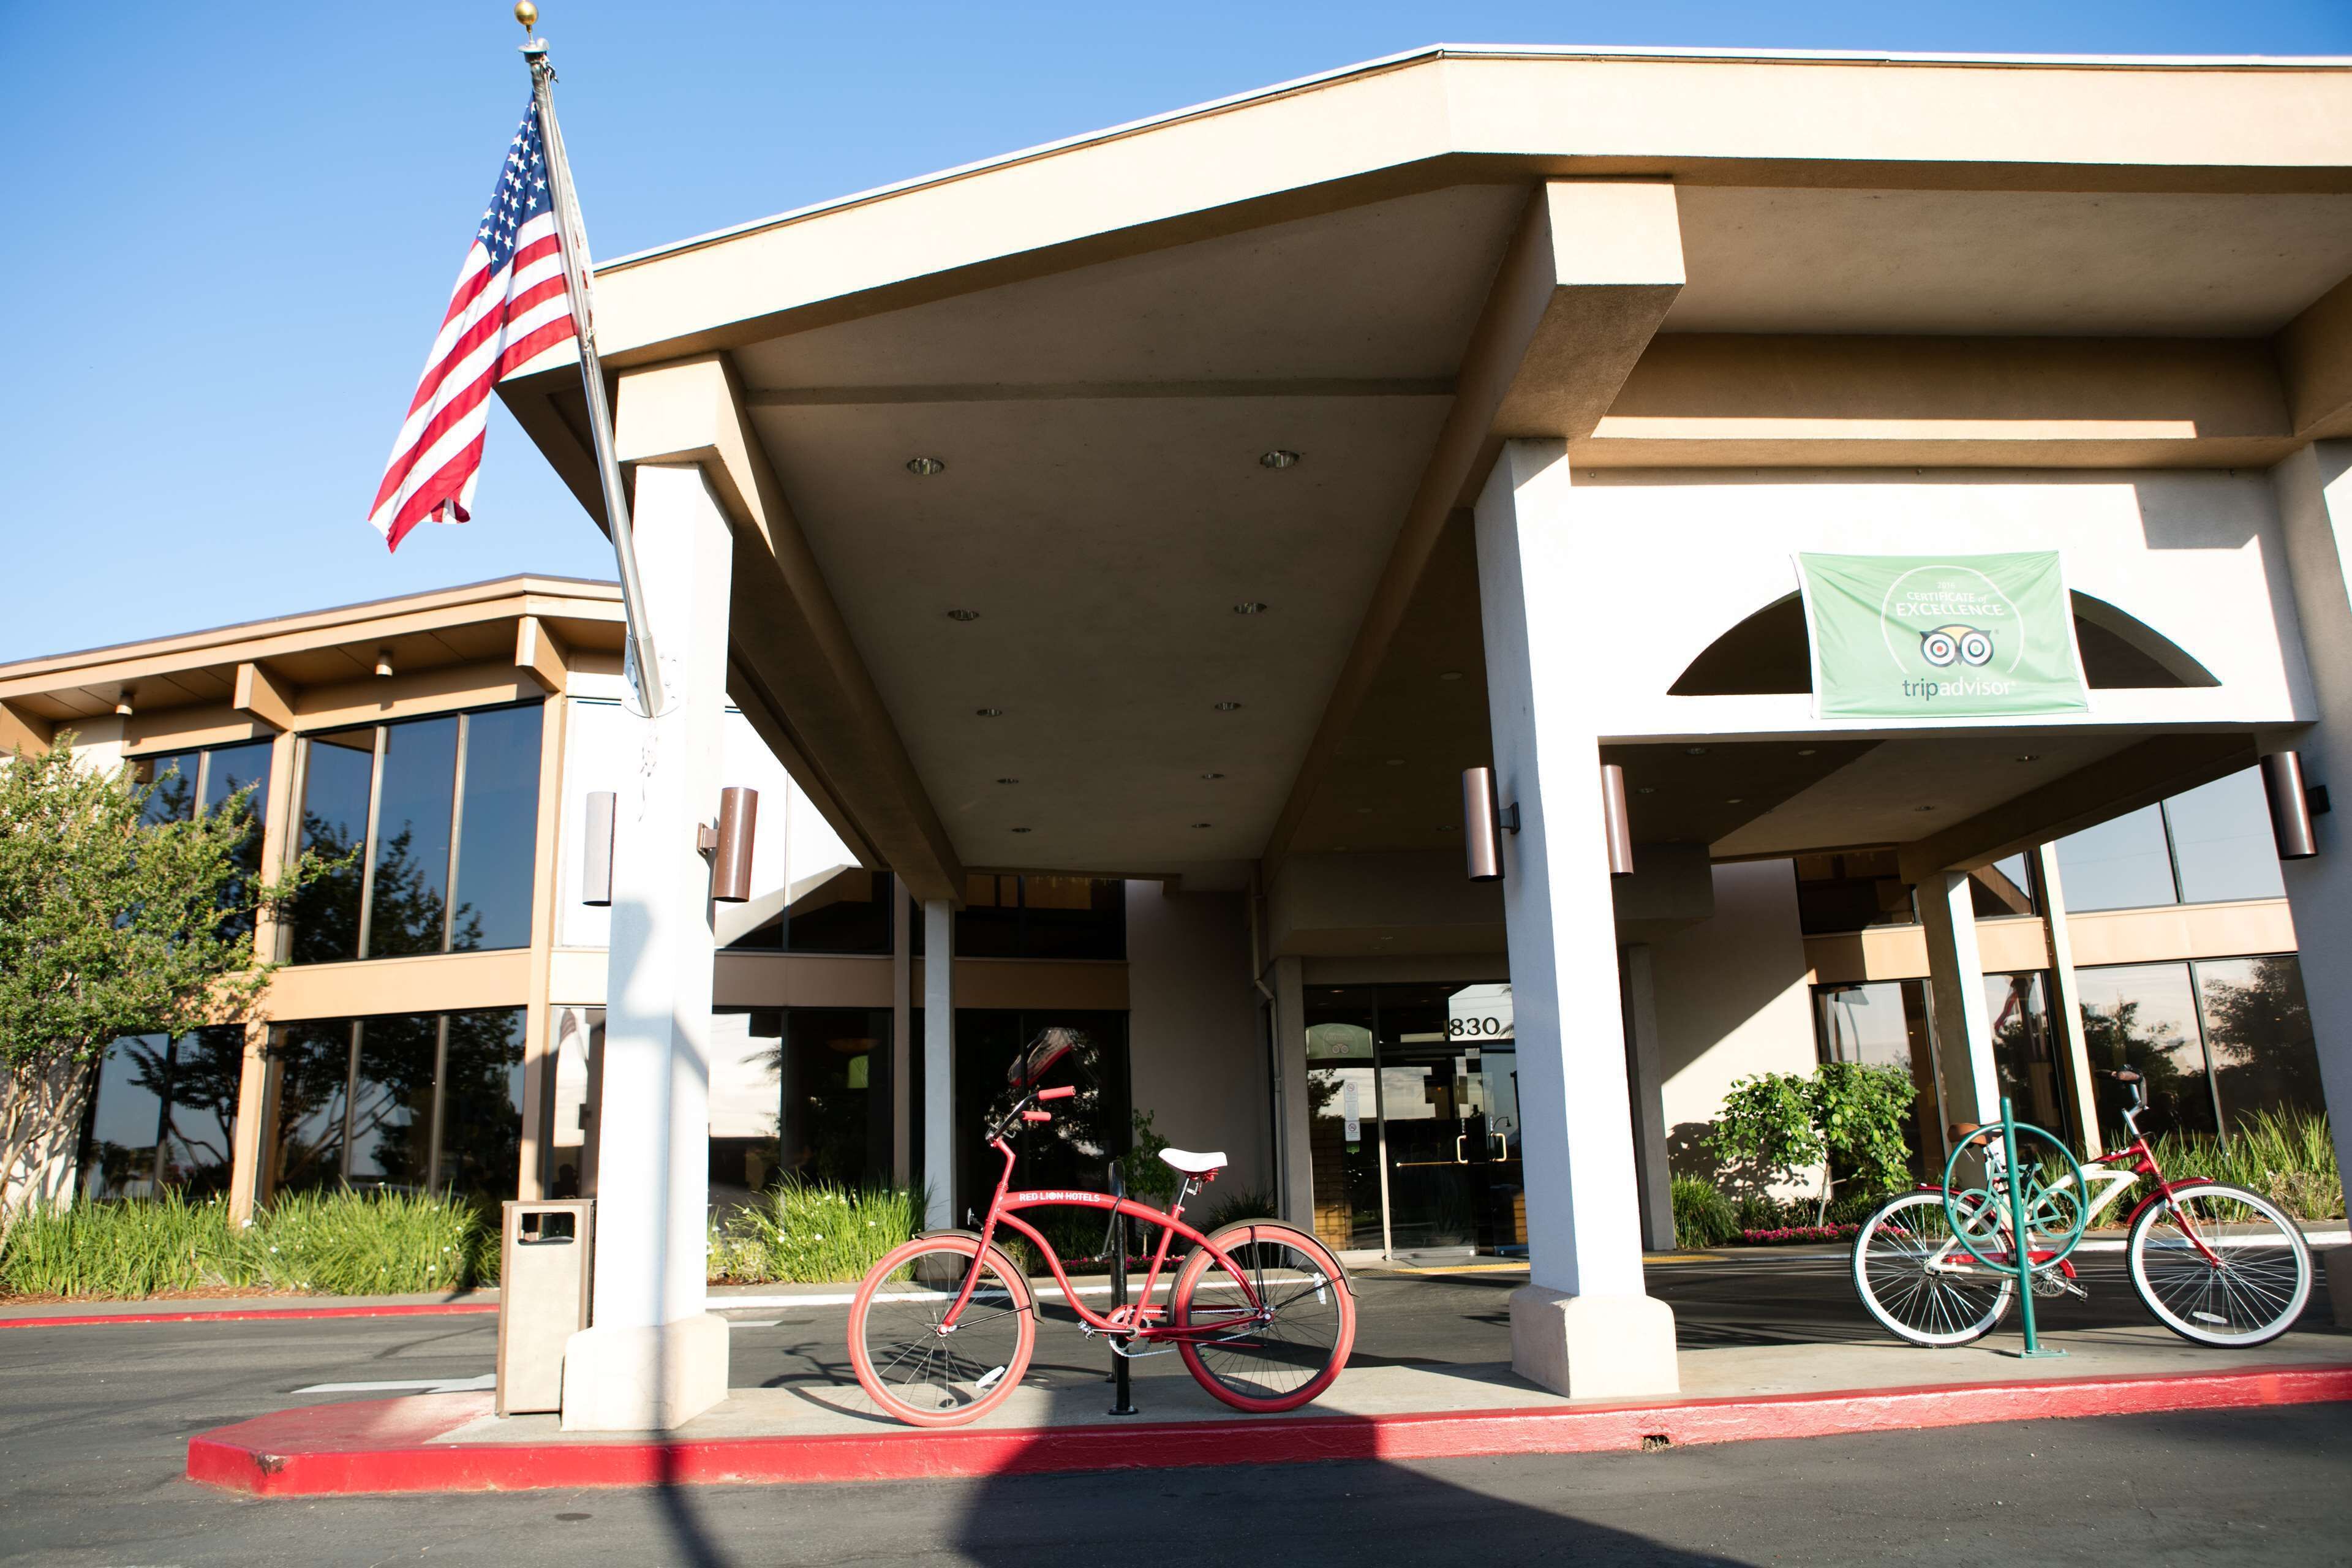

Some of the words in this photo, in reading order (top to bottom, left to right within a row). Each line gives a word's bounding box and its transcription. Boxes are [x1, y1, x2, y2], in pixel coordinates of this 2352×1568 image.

[1906, 592, 1975, 603] CERTIFICATE
[1978, 594, 1988, 604] of
[1896, 603, 2005, 617] EXCELLENCE
[1902, 676, 2011, 701] tripadvisor
[1450, 1017, 1500, 1036] 830
[1040, 1192, 1063, 1200] LION
[1066, 1193, 1101, 1202] HOTELS
